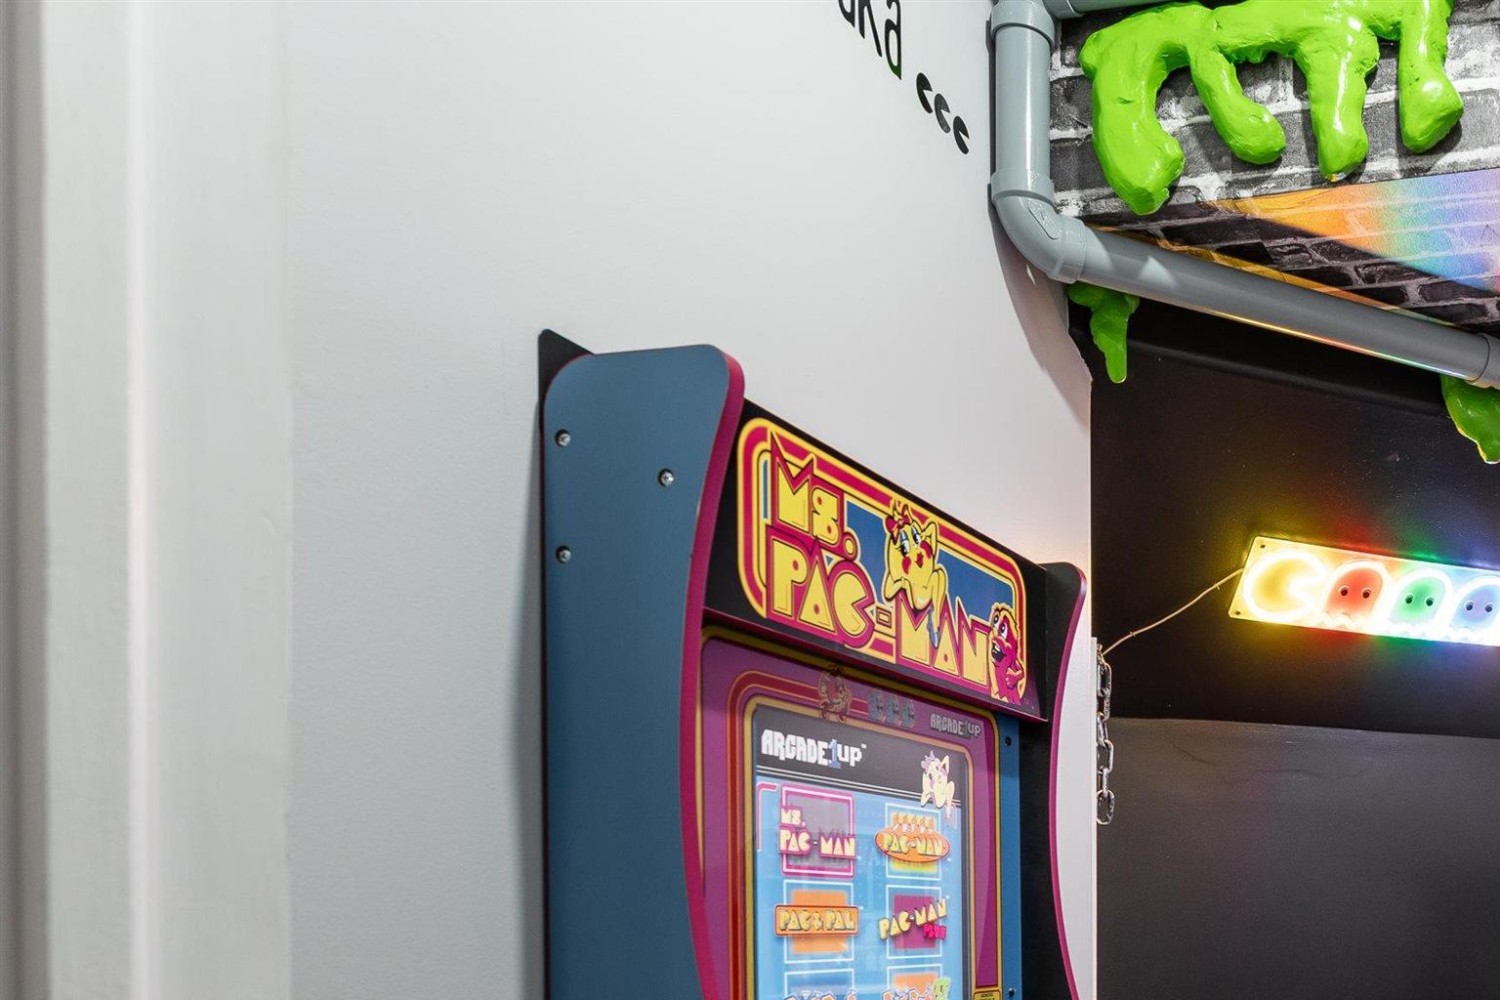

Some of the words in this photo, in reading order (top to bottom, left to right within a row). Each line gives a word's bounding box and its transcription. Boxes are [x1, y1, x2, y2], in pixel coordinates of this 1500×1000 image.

[769, 433, 859, 563] MS.
[767, 523, 990, 692] PAC-MAN
[778, 828, 857, 858] PAC-MAN
[879, 897, 948, 940] PAC-MAN
